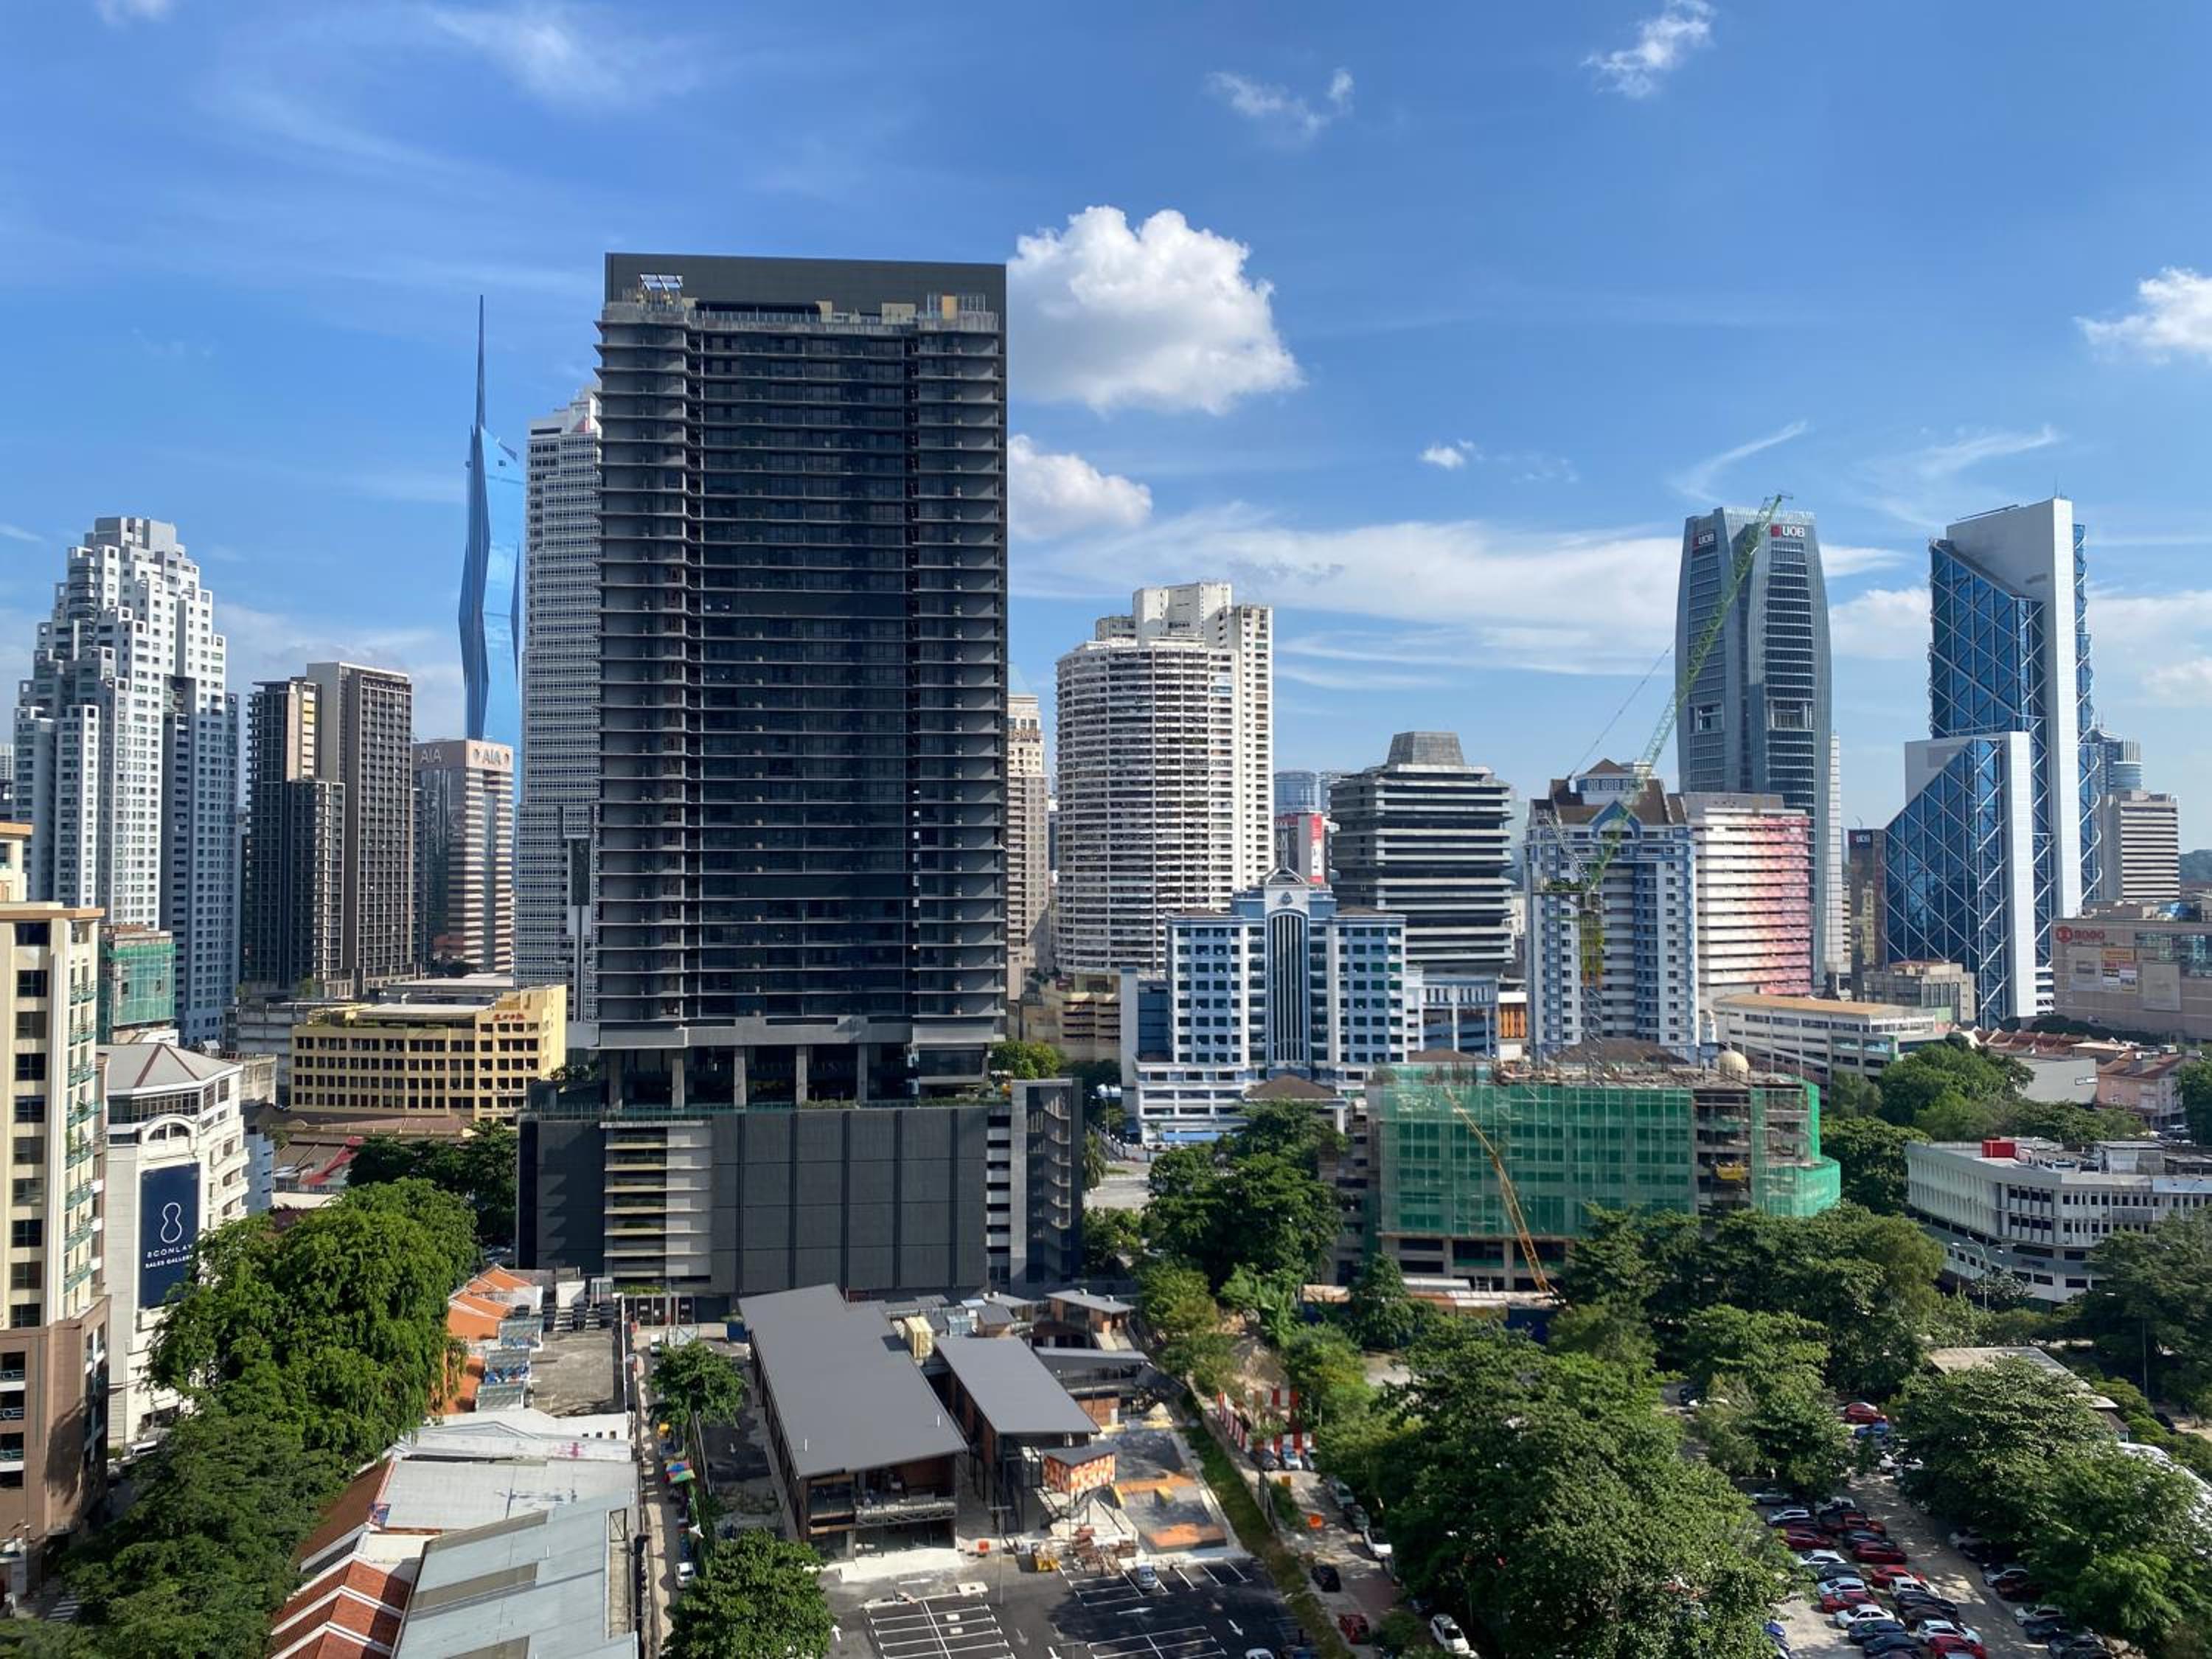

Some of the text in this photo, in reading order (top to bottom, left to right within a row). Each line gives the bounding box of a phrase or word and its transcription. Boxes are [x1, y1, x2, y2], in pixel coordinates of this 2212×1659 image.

[1782, 525, 1805, 538] UOB
[1698, 533, 1714, 545] UOB
[420, 748, 442, 764] AIA
[483, 748, 502, 765] AIA
[145, 1260, 164, 1268] SALES
